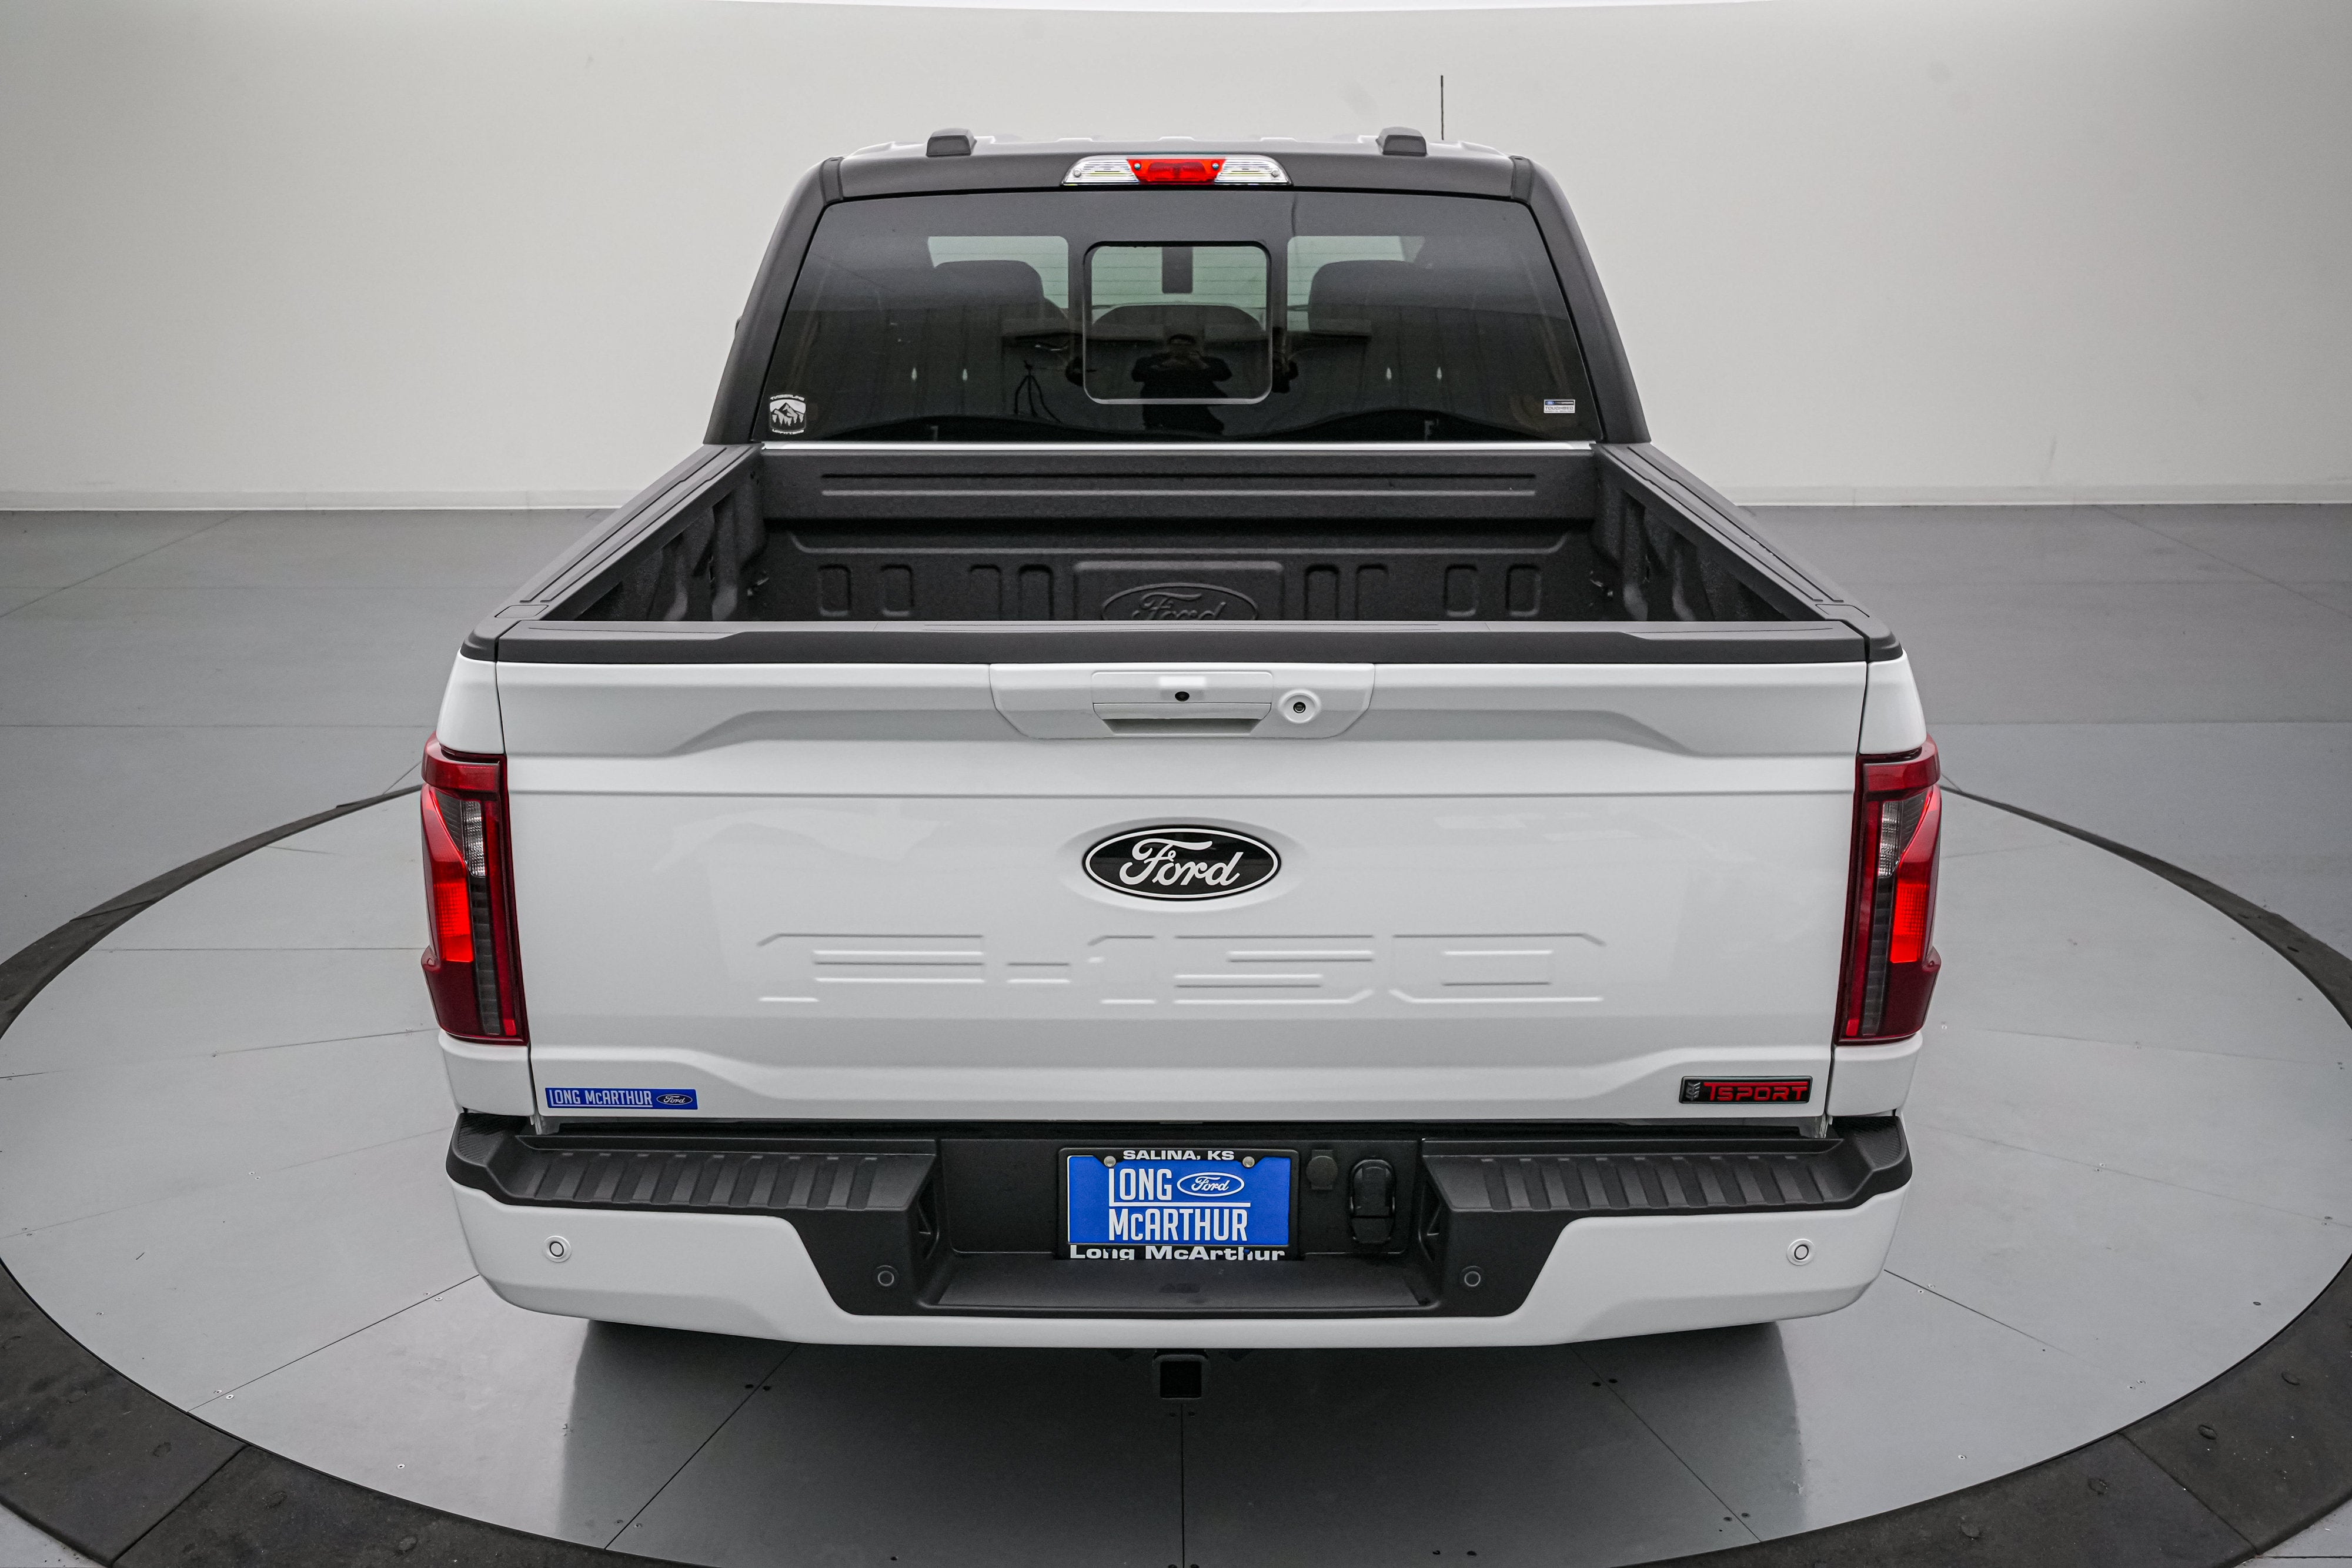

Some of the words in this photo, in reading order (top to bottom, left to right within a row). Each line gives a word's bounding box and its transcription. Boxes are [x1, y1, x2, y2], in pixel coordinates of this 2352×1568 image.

[1119, 838, 1244, 885] Ford
[549, 1089, 580, 1106] LONG
[663, 1095, 686, 1104] Ford
[1123, 1150, 1201, 1160] SALINA,
[1207, 1151, 1234, 1161] KS
[1109, 1168, 1172, 1206] LONG
[1191, 1176, 1230, 1191] Ford
[1109, 1208, 1248, 1242] McARTHUR
[1070, 1245, 1135, 1261] Long
[1145, 1245, 1285, 1261] McArthur
